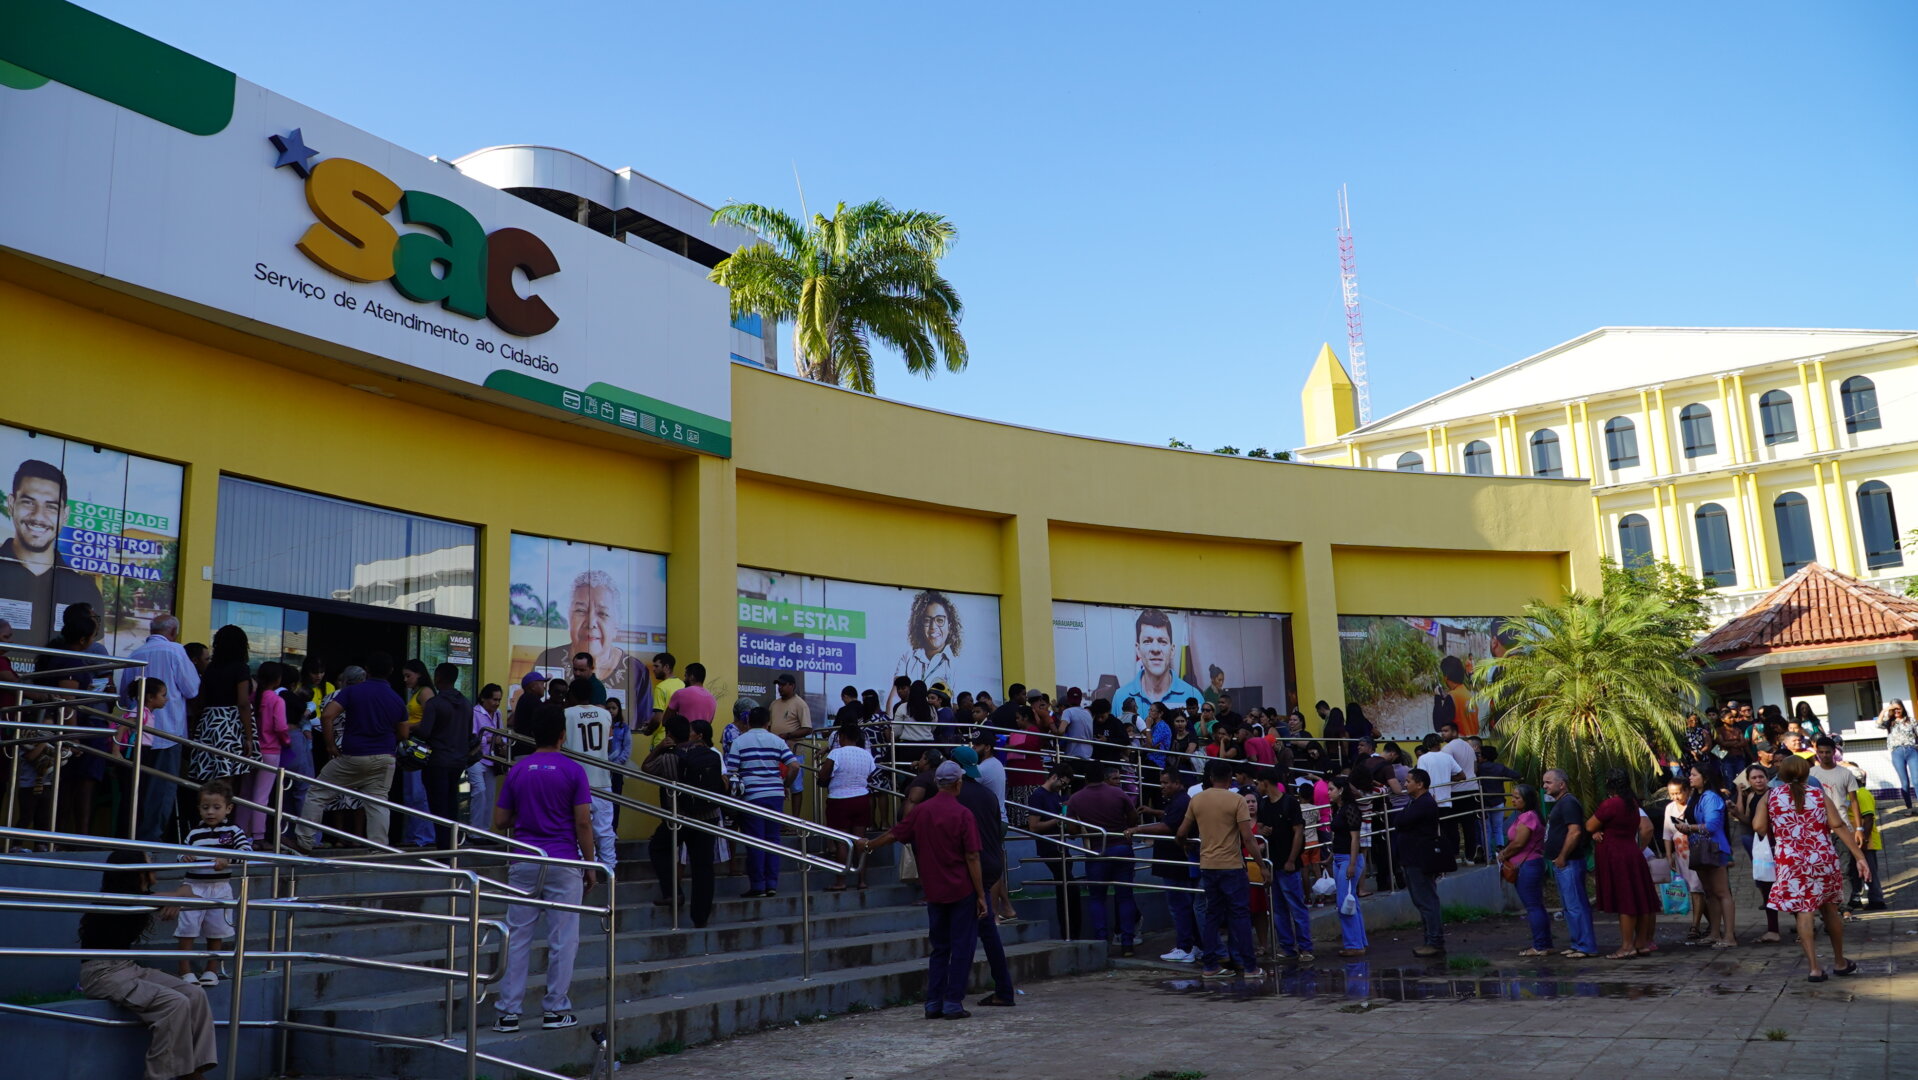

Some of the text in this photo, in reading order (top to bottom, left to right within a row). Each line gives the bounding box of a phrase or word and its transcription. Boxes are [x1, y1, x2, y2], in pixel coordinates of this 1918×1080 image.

[254, 262, 559, 374] Serviço de Atendimento ao Cidadão
[75, 502, 168, 529] SOCIEDADE
[101, 521, 120, 535] SE
[71, 543, 107, 559] COM
[72, 529, 156, 553] CONSTRÓI
[70, 557, 161, 580] CIDADANIA
[739, 603, 777, 624] BEM
[793, 610, 850, 632] ESTAR
[450, 636, 471, 644] VAGAS
[739, 634, 843, 658] É cuidar de si para
[739, 653, 843, 671] cuidar do próximo
[580, 711, 599, 719] VASCO
[577, 721, 603, 752] 10
